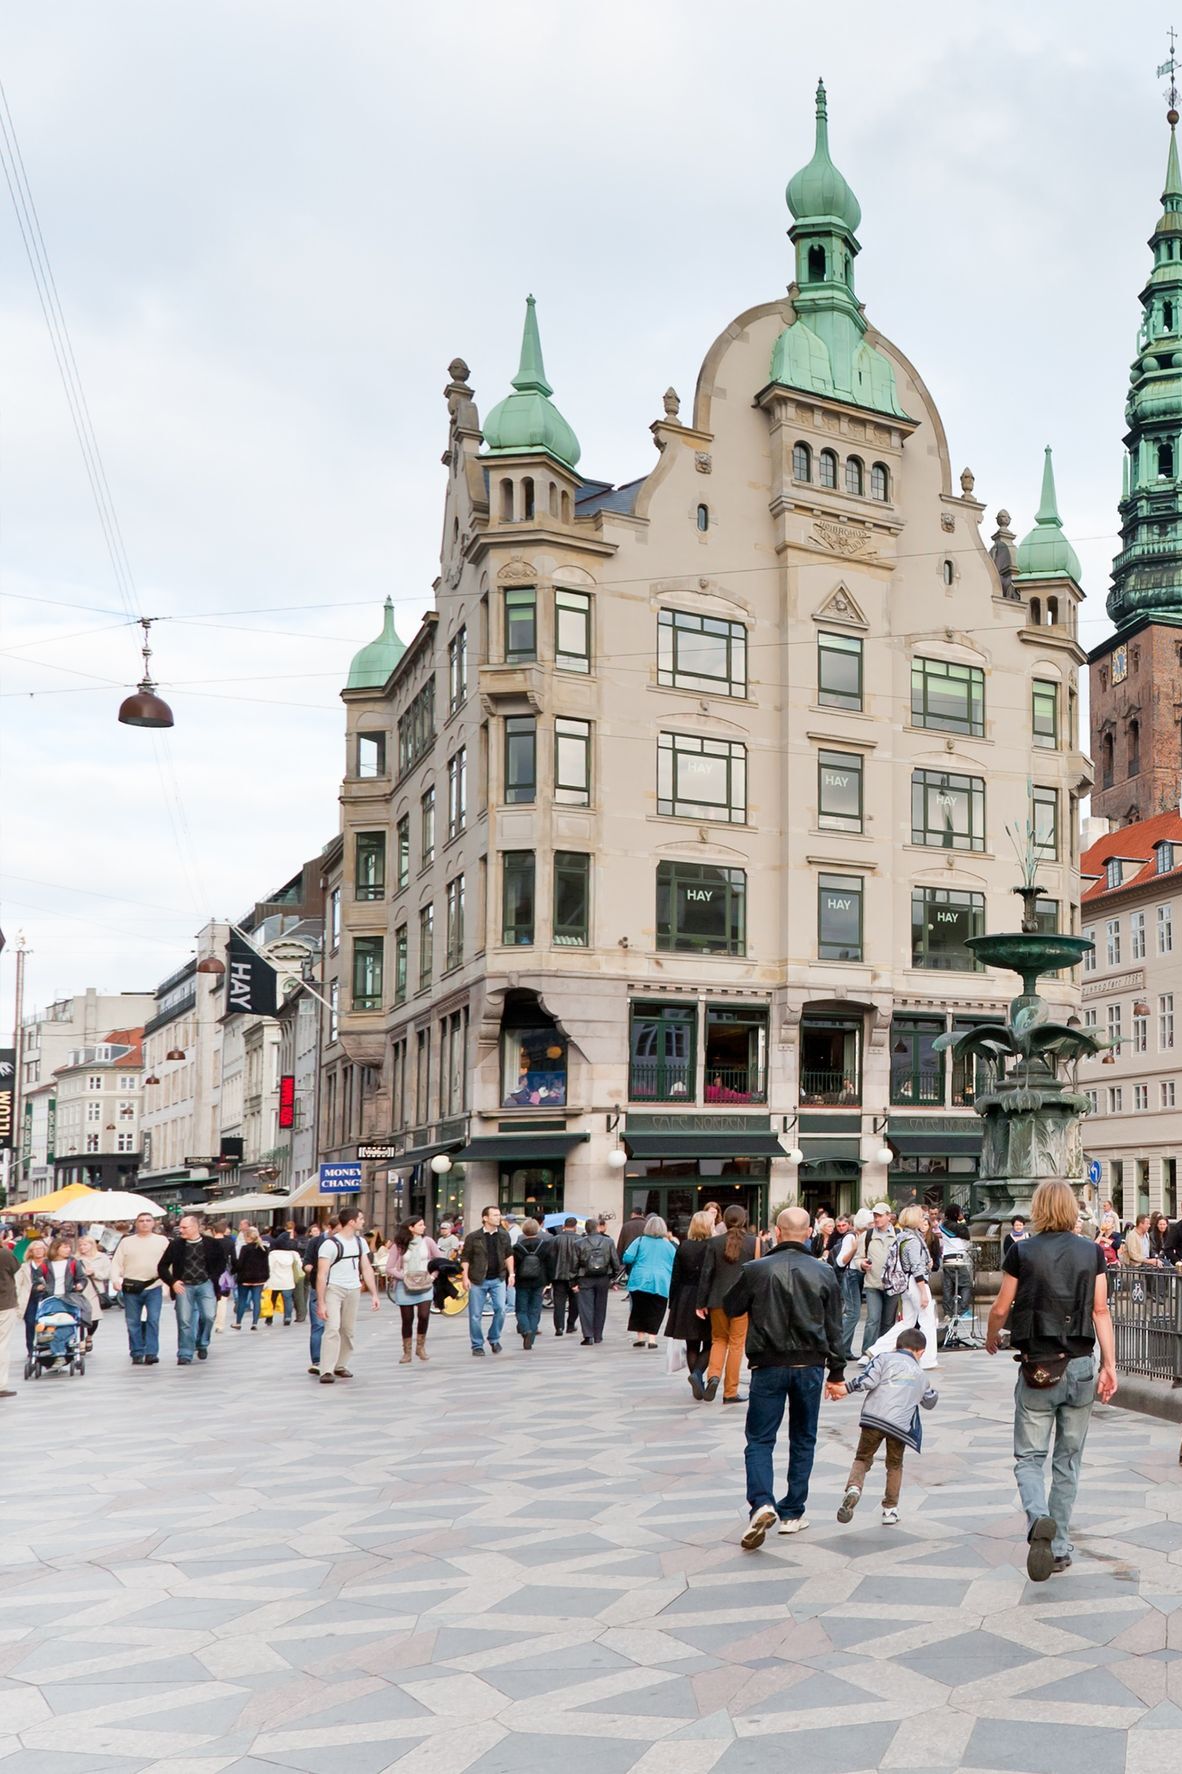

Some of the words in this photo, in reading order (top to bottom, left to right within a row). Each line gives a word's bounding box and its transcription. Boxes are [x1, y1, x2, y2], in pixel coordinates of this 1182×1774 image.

[687, 760, 713, 775] HAY
[825, 775, 849, 788] HAY
[936, 795, 958, 807] HAY
[687, 889, 713, 902] HAY
[827, 898, 851, 911] HAY
[936, 911, 959, 924] HAY
[230, 961, 252, 1011] HAY
[0, 1090, 11, 1137] ILLUM
[324, 1168, 361, 1177] MONEY
[321, 1179, 362, 1188] CHANG
